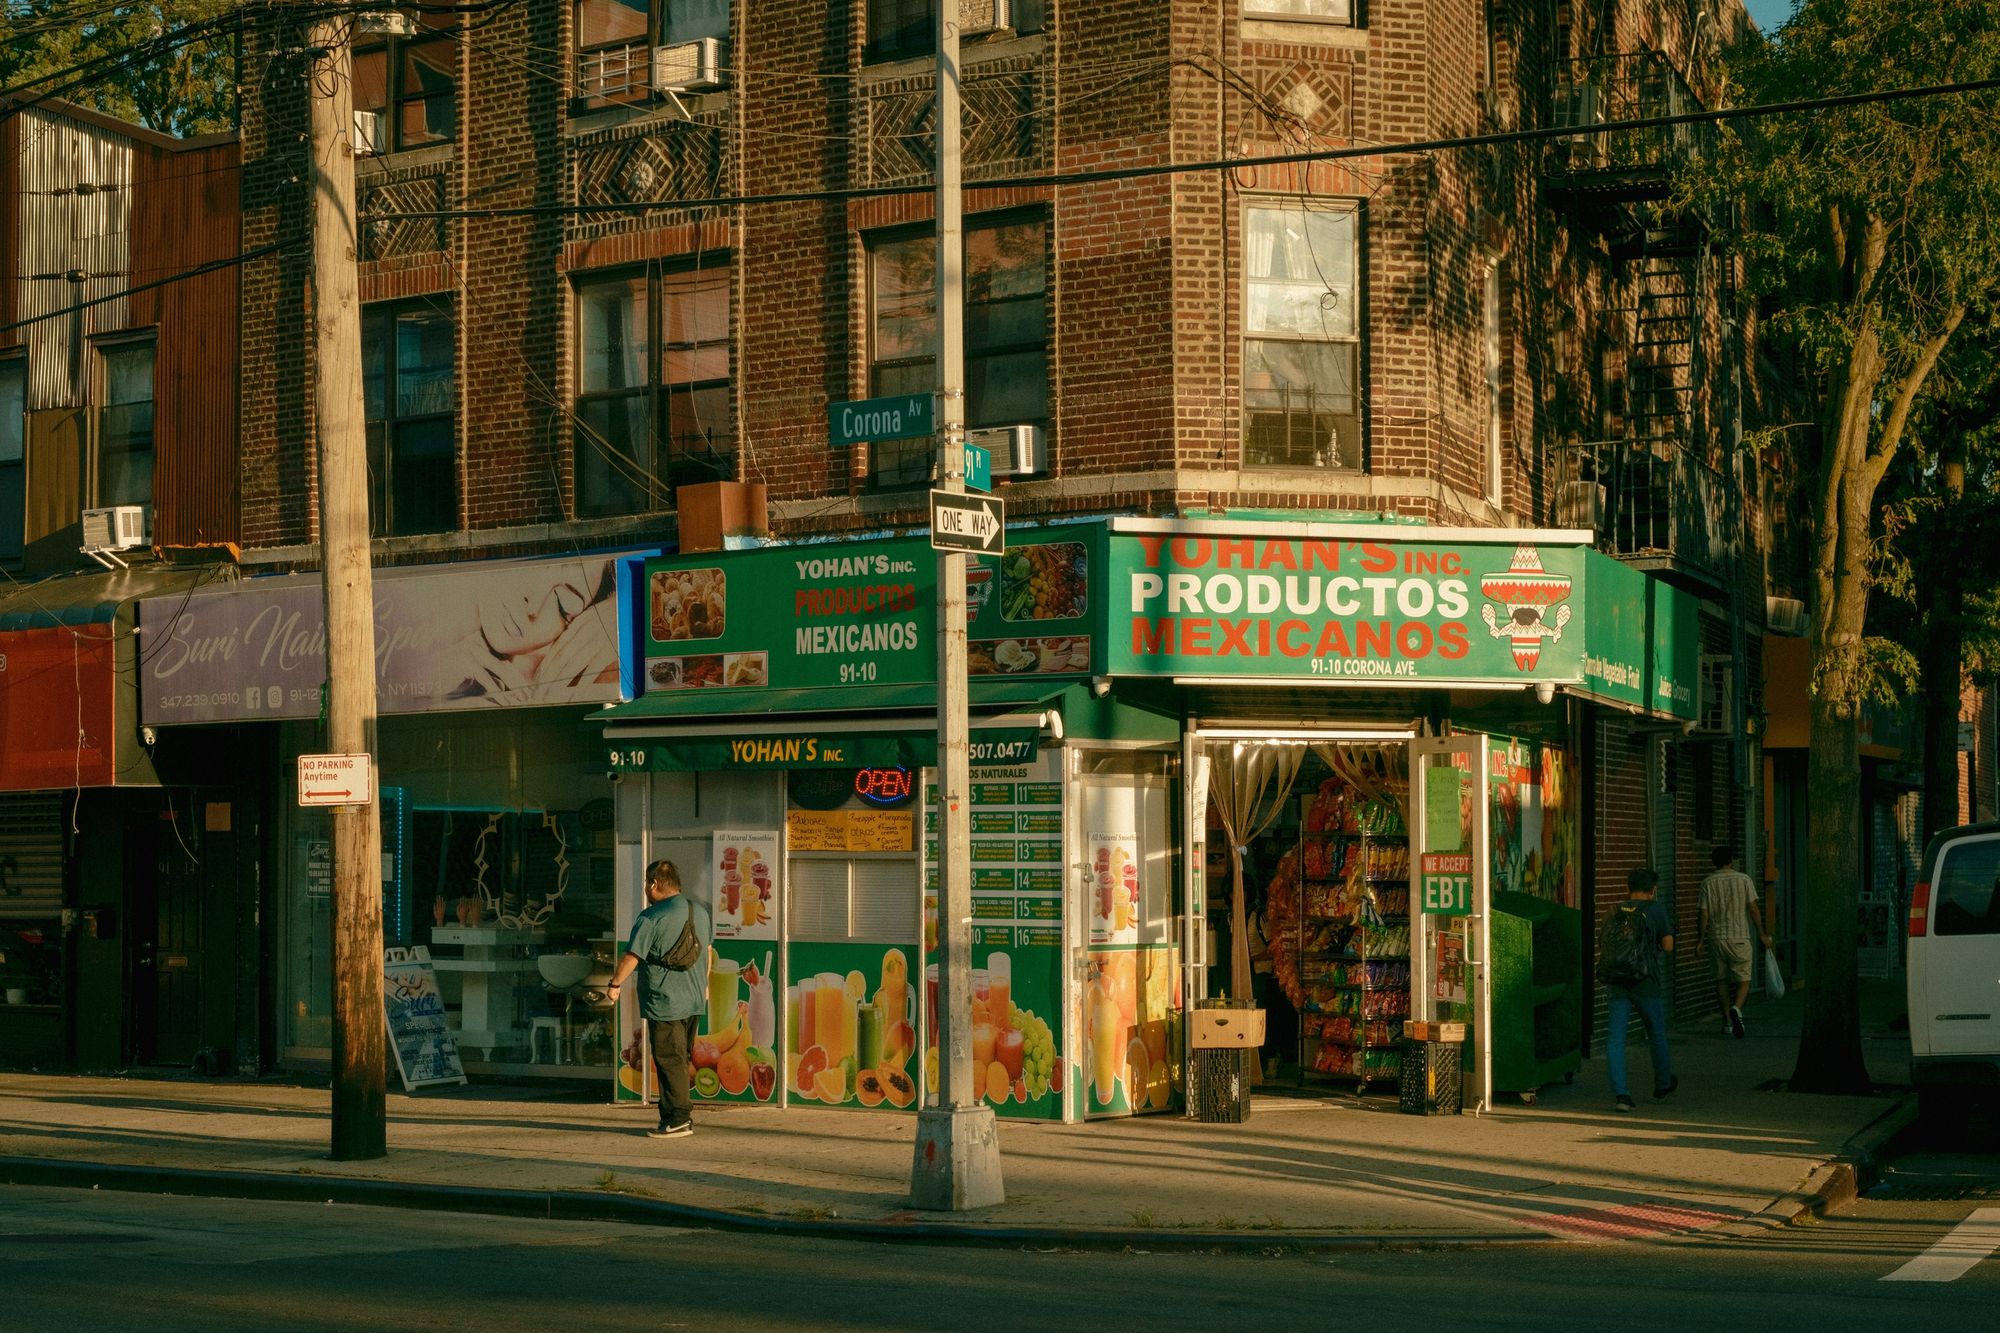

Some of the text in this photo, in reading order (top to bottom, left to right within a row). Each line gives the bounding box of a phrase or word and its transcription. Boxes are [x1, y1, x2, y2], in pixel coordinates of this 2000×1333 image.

[843, 399, 922, 438] Corona Av
[965, 449, 974, 480] 91
[942, 510, 993, 536] ONE WAY
[1137, 535, 1471, 576] YOHAN'S INC.
[796, 555, 916, 580] YOHAN'S INC.
[795, 584, 916, 617] PRODUCTOS
[1131, 573, 1470, 619] PRODUCTOS
[154, 613, 238, 678] Suri
[244, 605, 328, 671] Nai
[796, 622, 918, 655] MEXICANOS
[1131, 617, 1472, 660] MEXICANOS
[840, 662, 877, 683] 91-10
[1310, 658, 1418, 676] 91-10 CORONA AVE.
[388, 684, 408, 697] NY
[160, 692, 240, 709] 347.239.0910
[610, 751, 644, 766] 91-10
[732, 738, 844, 763] YOHAN'S INC.
[303, 760, 354, 770] NO PARKING
[981, 768, 1028, 779] NATURALES
[304, 772, 338, 782] Anytime
[856, 770, 912, 796] OPEN
[971, 786, 976, 802] 5
[1018, 786, 1028, 802] 11
[970, 814, 977, 830] 6
[1018, 814, 1029, 830] 12
[971, 843, 976, 859] 7
[1018, 843, 1030, 859] 13
[1425, 854, 1470, 871] WE ACCEPT
[971, 872, 976, 888] 8
[1018, 872, 1030, 888] 14
[1425, 876, 1468, 909] EBT
[1018, 900, 1030, 916] 15
[1454, 920, 1473, 930] PUH
[1018, 929, 1030, 945] 16
